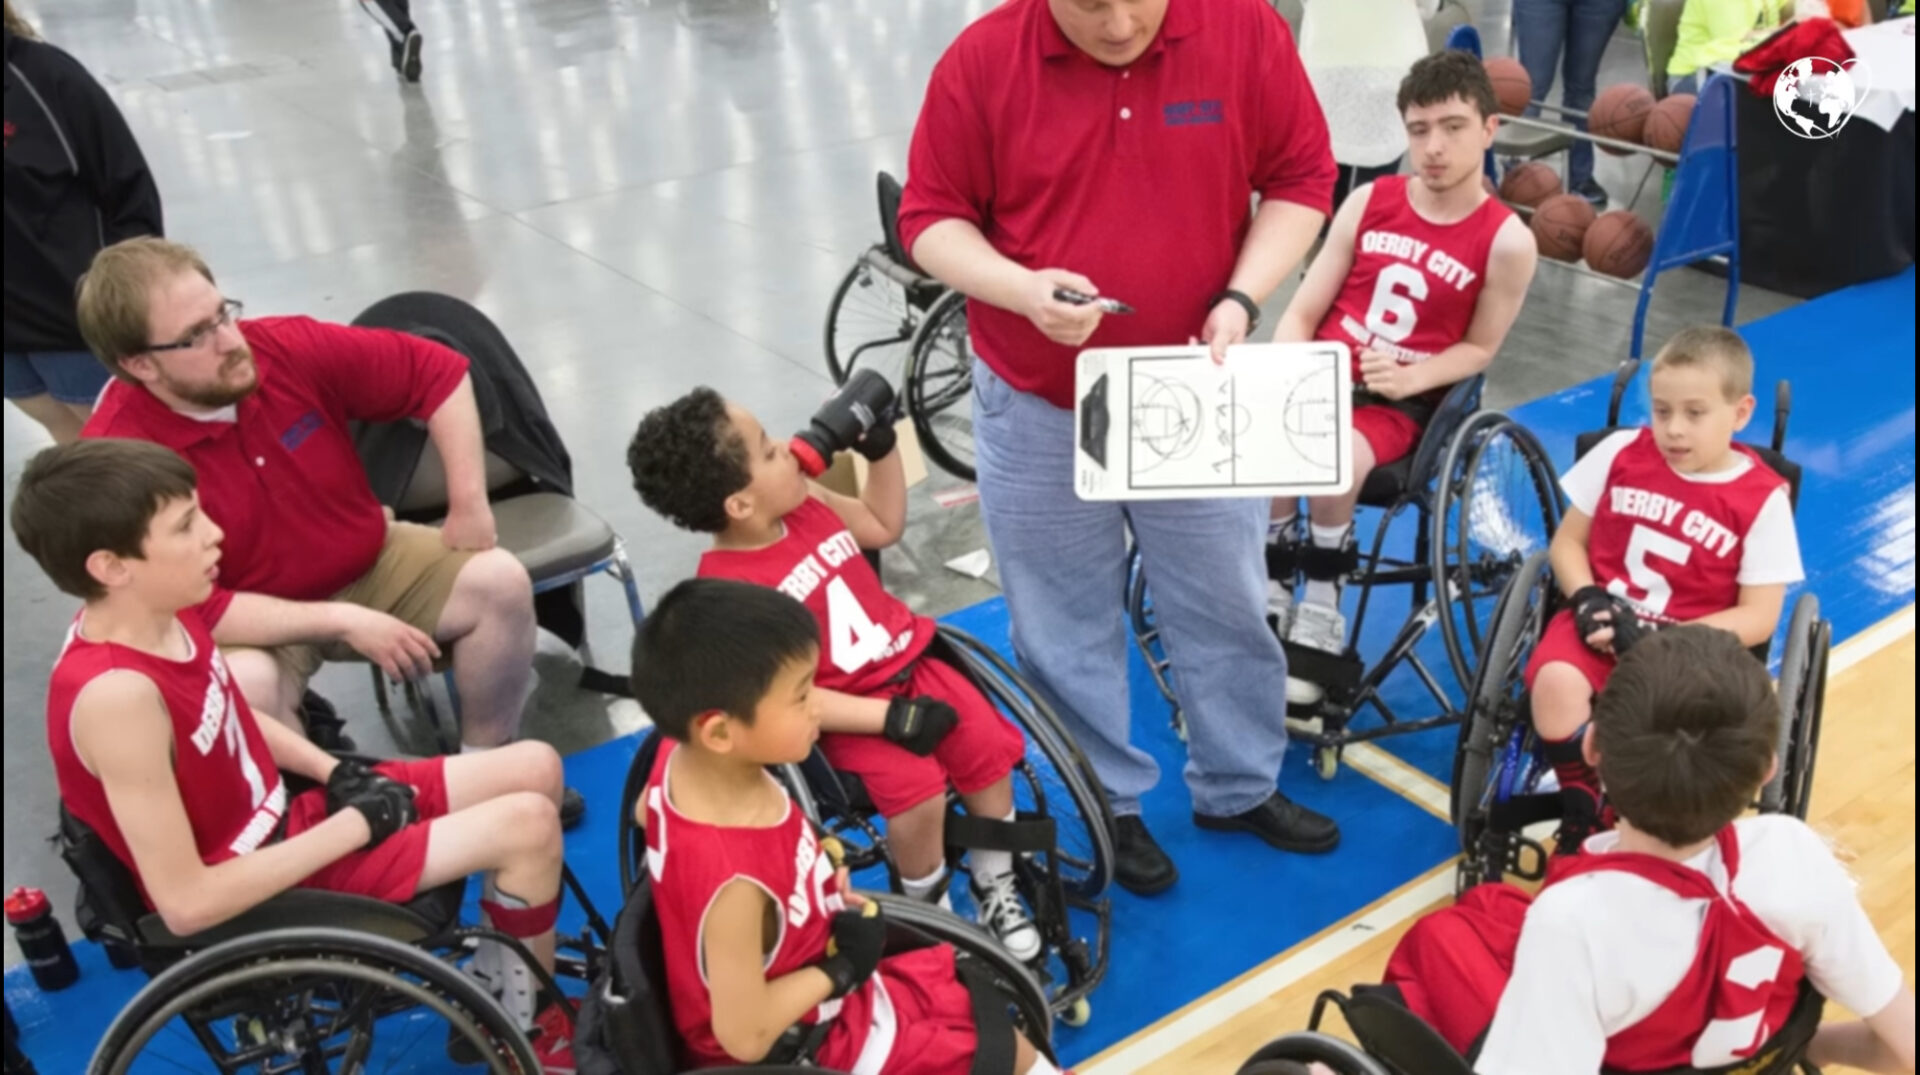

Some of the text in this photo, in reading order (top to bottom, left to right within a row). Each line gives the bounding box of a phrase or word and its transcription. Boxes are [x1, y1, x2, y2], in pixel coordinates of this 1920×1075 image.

[1361, 229, 1477, 292] DERBY CITY
[1365, 262, 1429, 344] 6
[1610, 486, 1739, 559] DERBY CITY
[776, 553, 829, 604] RBY
[1606, 523, 1693, 615] 5
[825, 574, 892, 675] 4
[223, 688, 268, 811] 7
